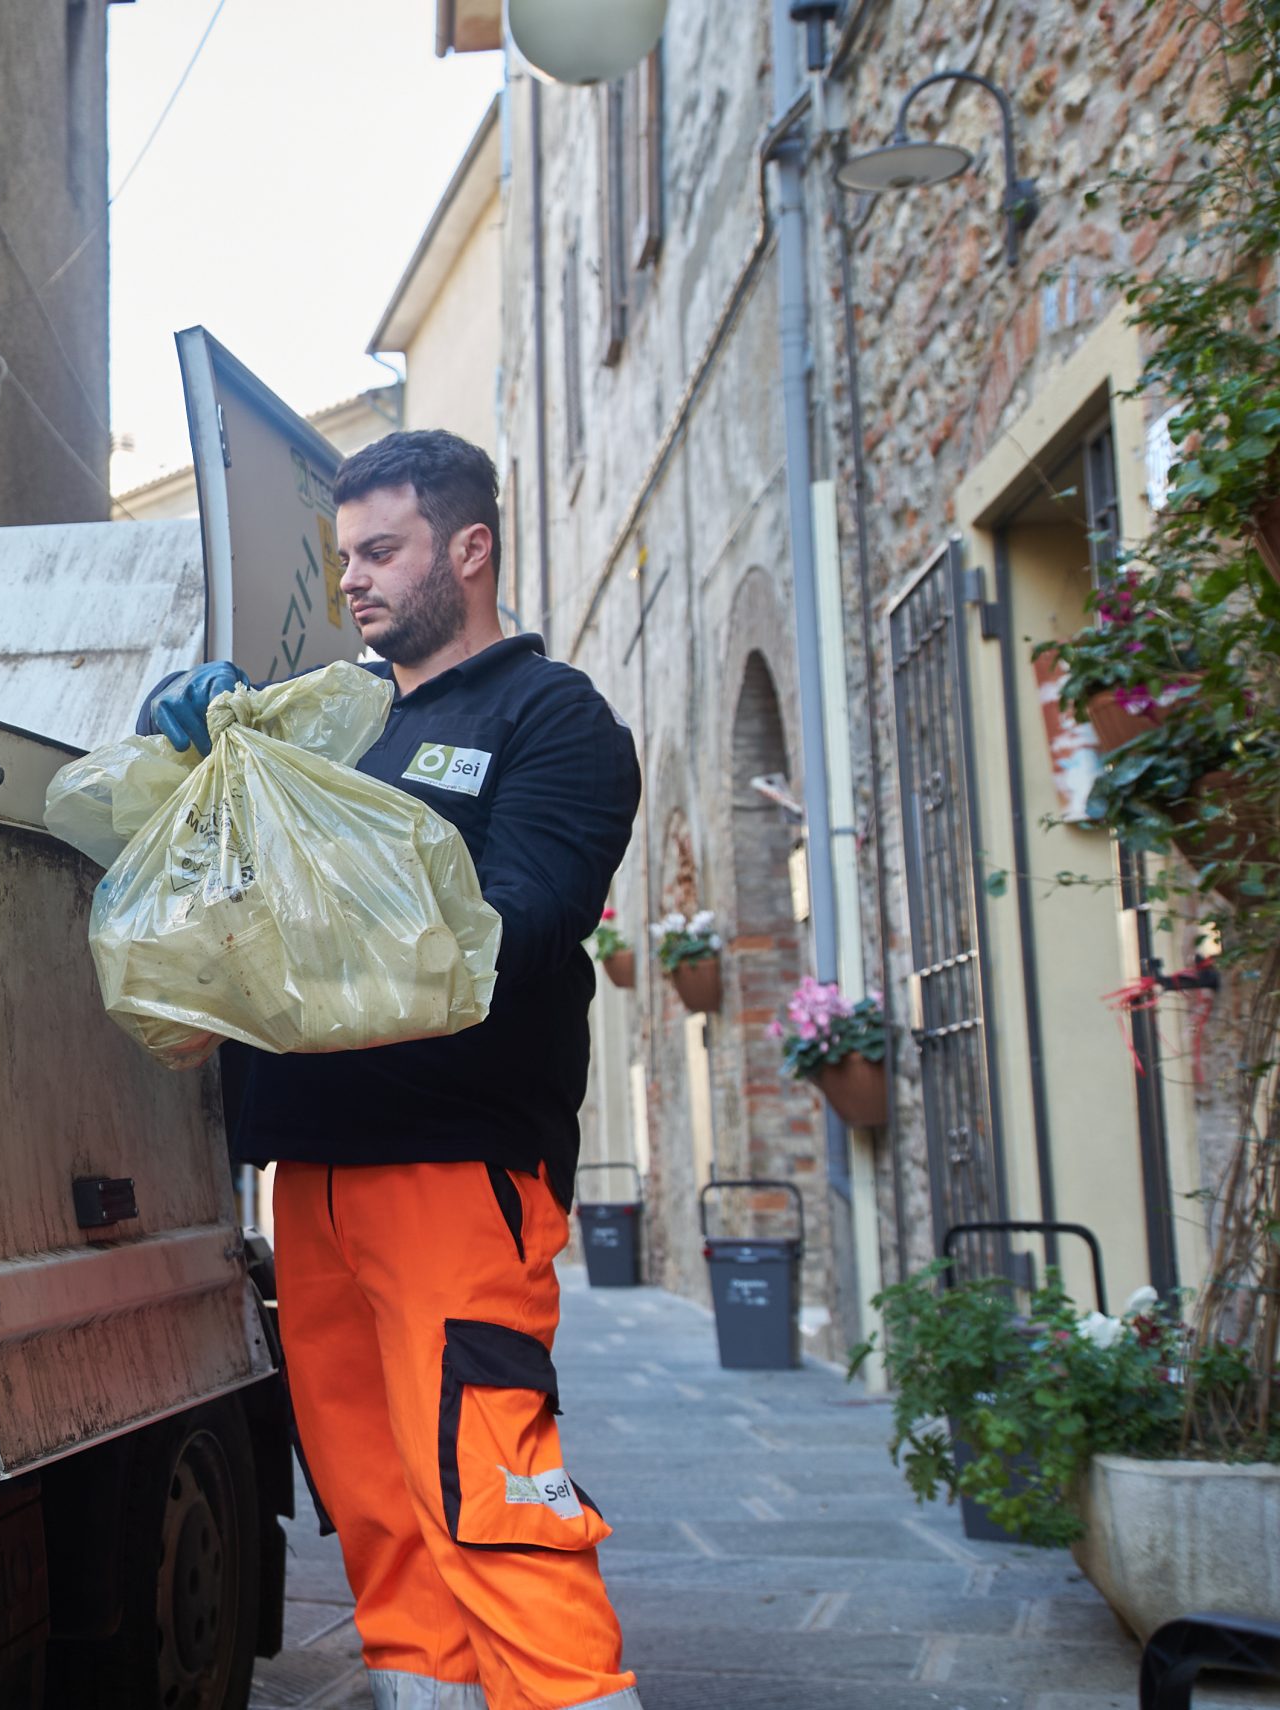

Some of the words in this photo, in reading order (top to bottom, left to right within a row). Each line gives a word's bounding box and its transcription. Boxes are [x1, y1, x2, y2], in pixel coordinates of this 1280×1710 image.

[417, 744, 446, 772] 6
[452, 759, 481, 777] Sei
[544, 1479, 571, 1502] Sei
